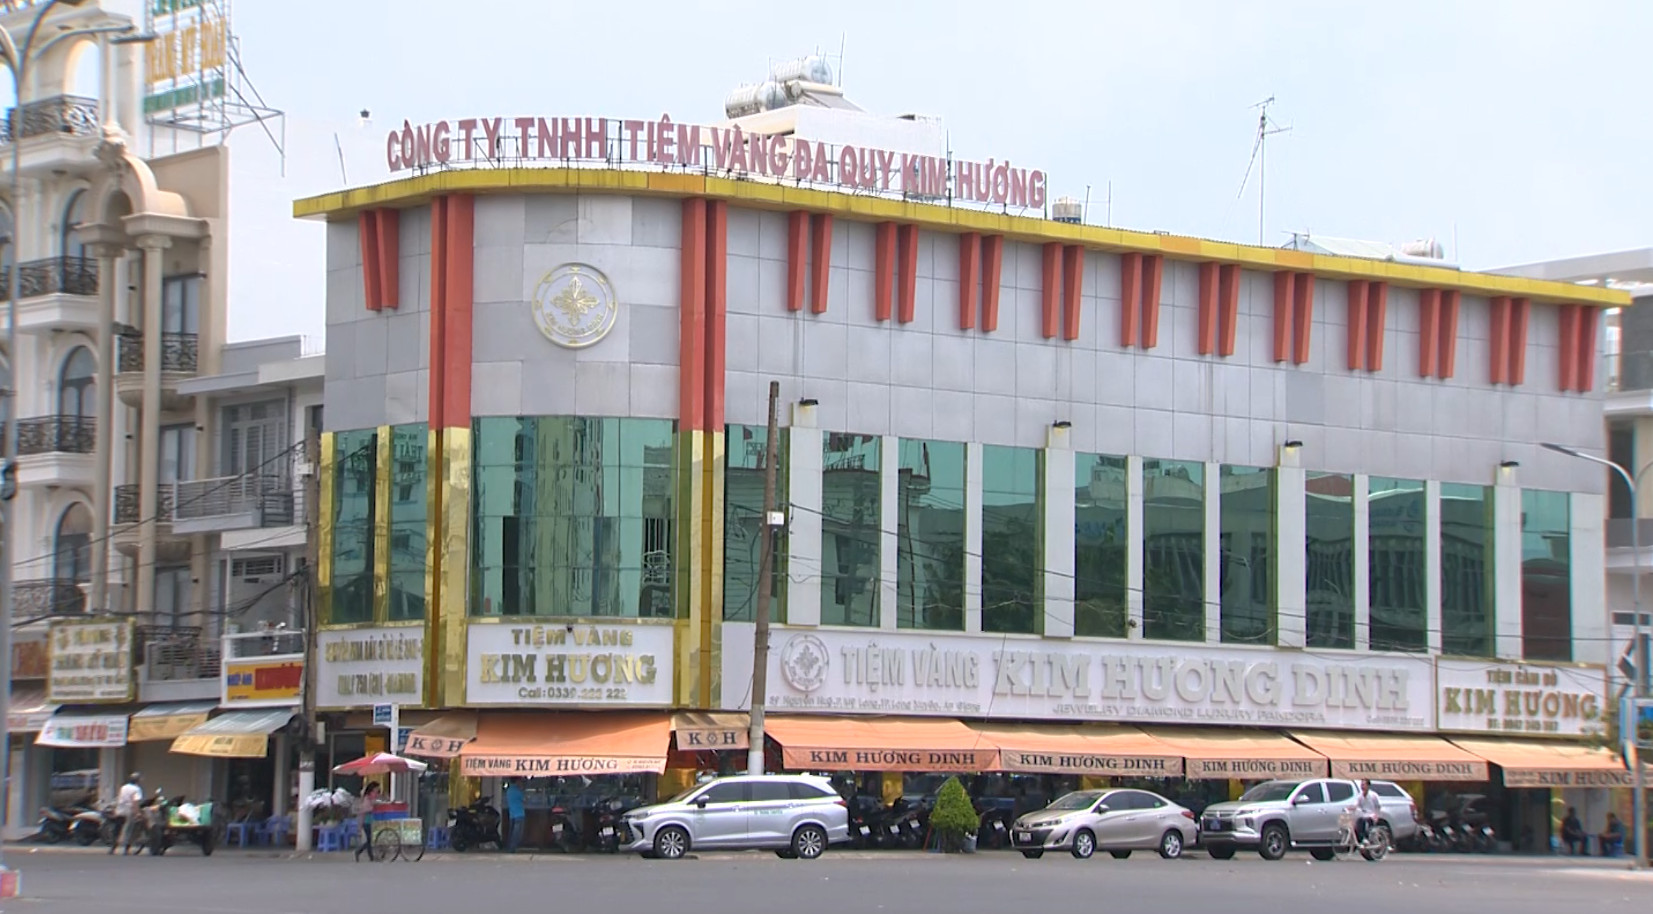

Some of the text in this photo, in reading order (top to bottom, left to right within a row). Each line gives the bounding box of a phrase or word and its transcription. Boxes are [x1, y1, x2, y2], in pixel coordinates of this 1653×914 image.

[388, 119, 450, 172] CÔNG
[459, 117, 501, 160] TY
[515, 117, 606, 159] TNHH
[625, 113, 700, 169] TIỆM
[711, 123, 788, 176] VÀNG
[901, 153, 947, 196] KIM
[957, 158, 1044, 209] HƯƠNG
[512, 626, 632, 649] TIỆM VÀNG
[480, 652, 657, 685] KIM HƯƠNG
[841, 642, 905, 693] TIỆM
[912, 642, 979, 689] VÀNG
[993, 650, 1090, 699] KIM
[1101, 655, 1281, 707] HƯƠNG
[1292, 663, 1410, 711] DINH
[1444, 687, 1598, 720] KIM HƯƠNG
[1052, 703, 1121, 716] JEWELRY
[1126, 705, 1193, 718] DIAMOND
[1196, 708, 1251, 721] LUXURY
[411, 737, 426, 750] K
[447, 740, 464, 752] H
[688, 732, 736, 745] K H
[465, 757, 485, 770] TIỆM
[489, 756, 511, 769] VÀNG
[515, 759, 550, 771] KIM
[557, 757, 617, 771] HƯƠNG
[810, 750, 975, 765] KIM HƯƠNG DINH
[1020, 753, 1165, 770] KIM HƯƠNG DINH
[1202, 759, 1312, 773] KIM HƯƠNG DINH
[1349, 761, 1472, 775] KIM HƯƠNG DINH
[1539, 770, 1569, 785] KIM
[1575, 769, 1633, 785] HƯƠNG
